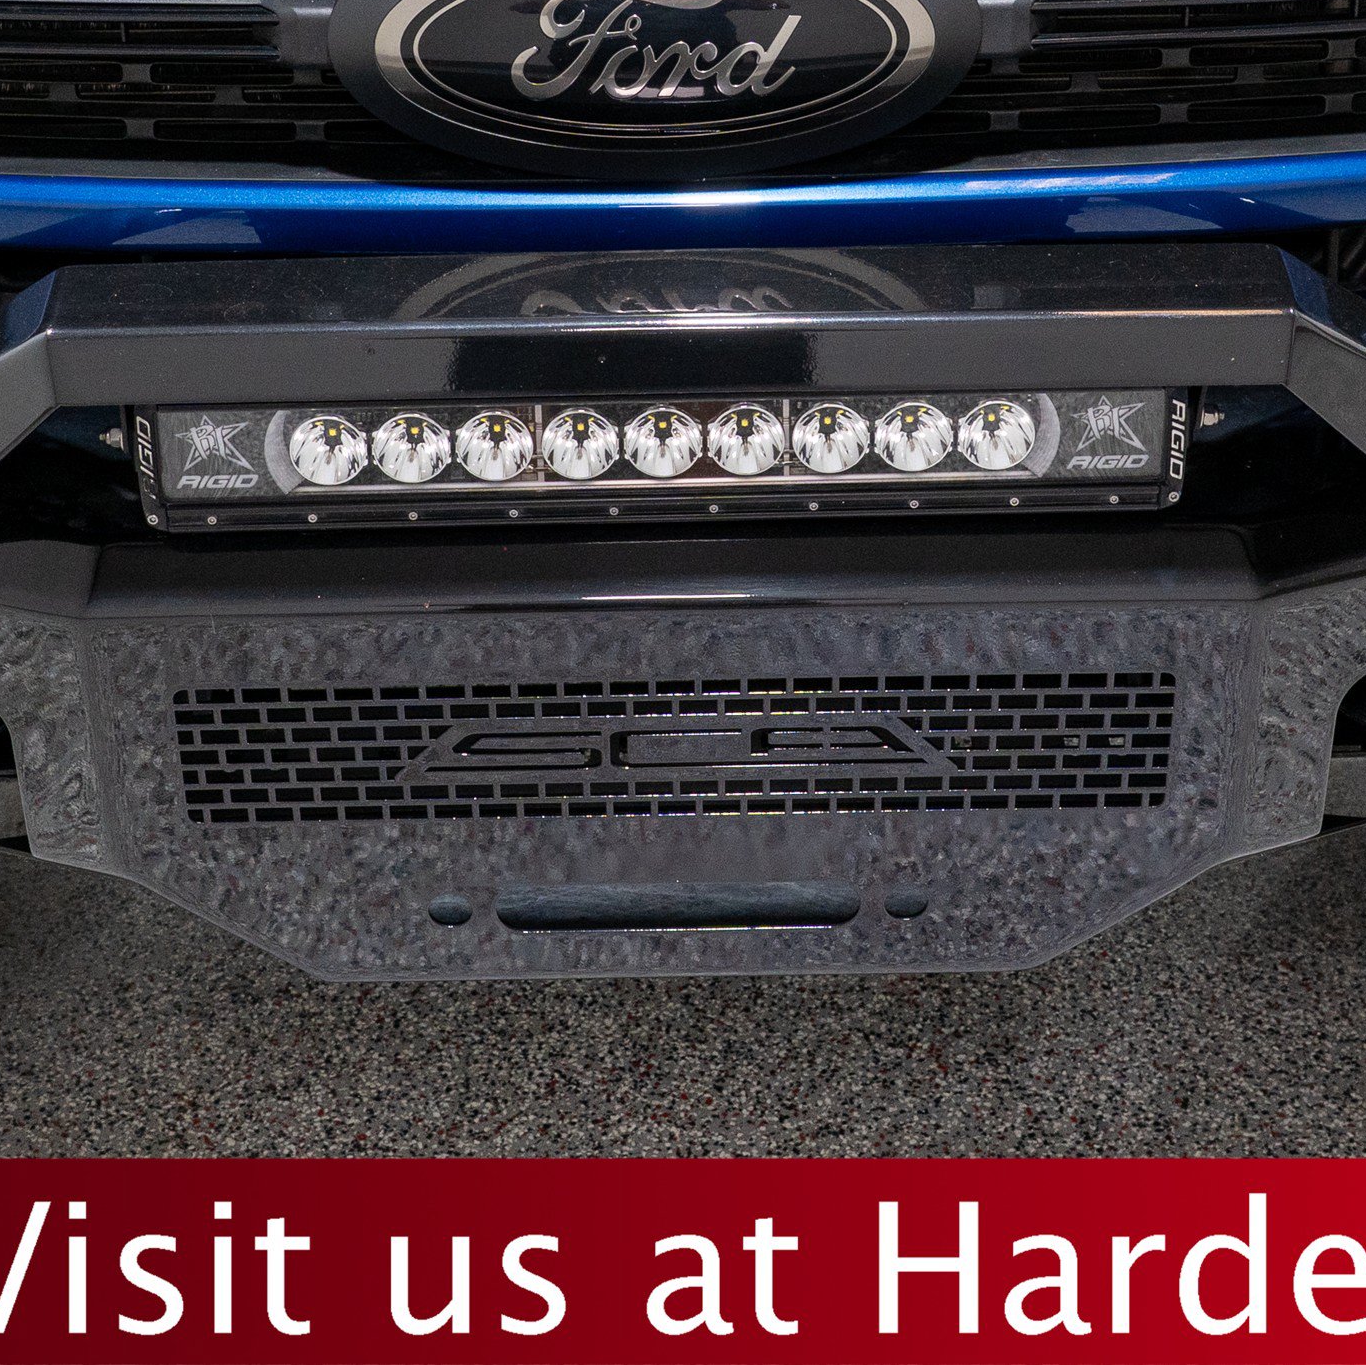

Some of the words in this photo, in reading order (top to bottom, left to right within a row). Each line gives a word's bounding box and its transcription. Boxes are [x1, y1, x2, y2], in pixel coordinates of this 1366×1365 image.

[1169, 398, 1187, 481] RIGID
[1066, 454, 1150, 471] RIGID
[176, 474, 260, 490] RIGID
